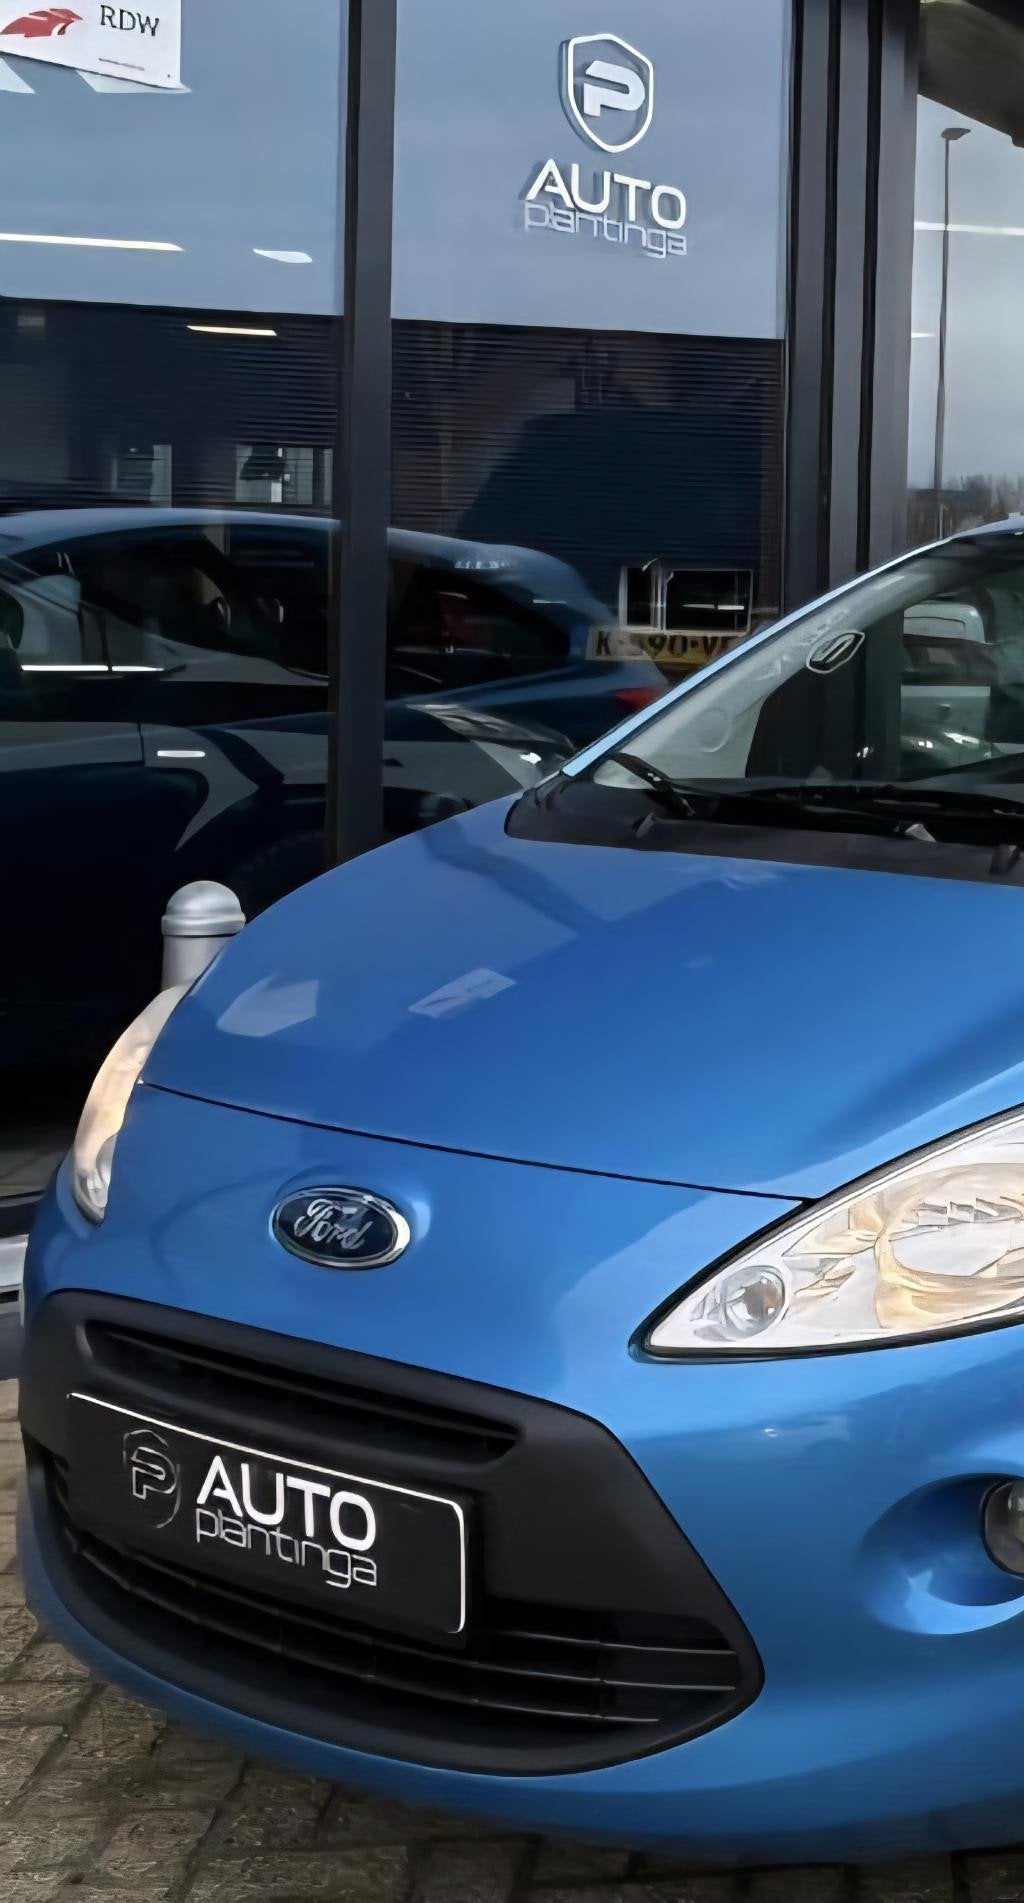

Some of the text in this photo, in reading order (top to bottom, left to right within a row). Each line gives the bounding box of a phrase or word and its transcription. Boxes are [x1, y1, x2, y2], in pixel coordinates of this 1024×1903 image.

[100, 4, 160, 37] RDW
[524, 158, 687, 230] AUTO
[524, 199, 687, 259] plantinga
[294, 1198, 374, 1250] Ford
[196, 1455, 377, 1551] AUTO
[196, 1508, 377, 1589] plantinga
